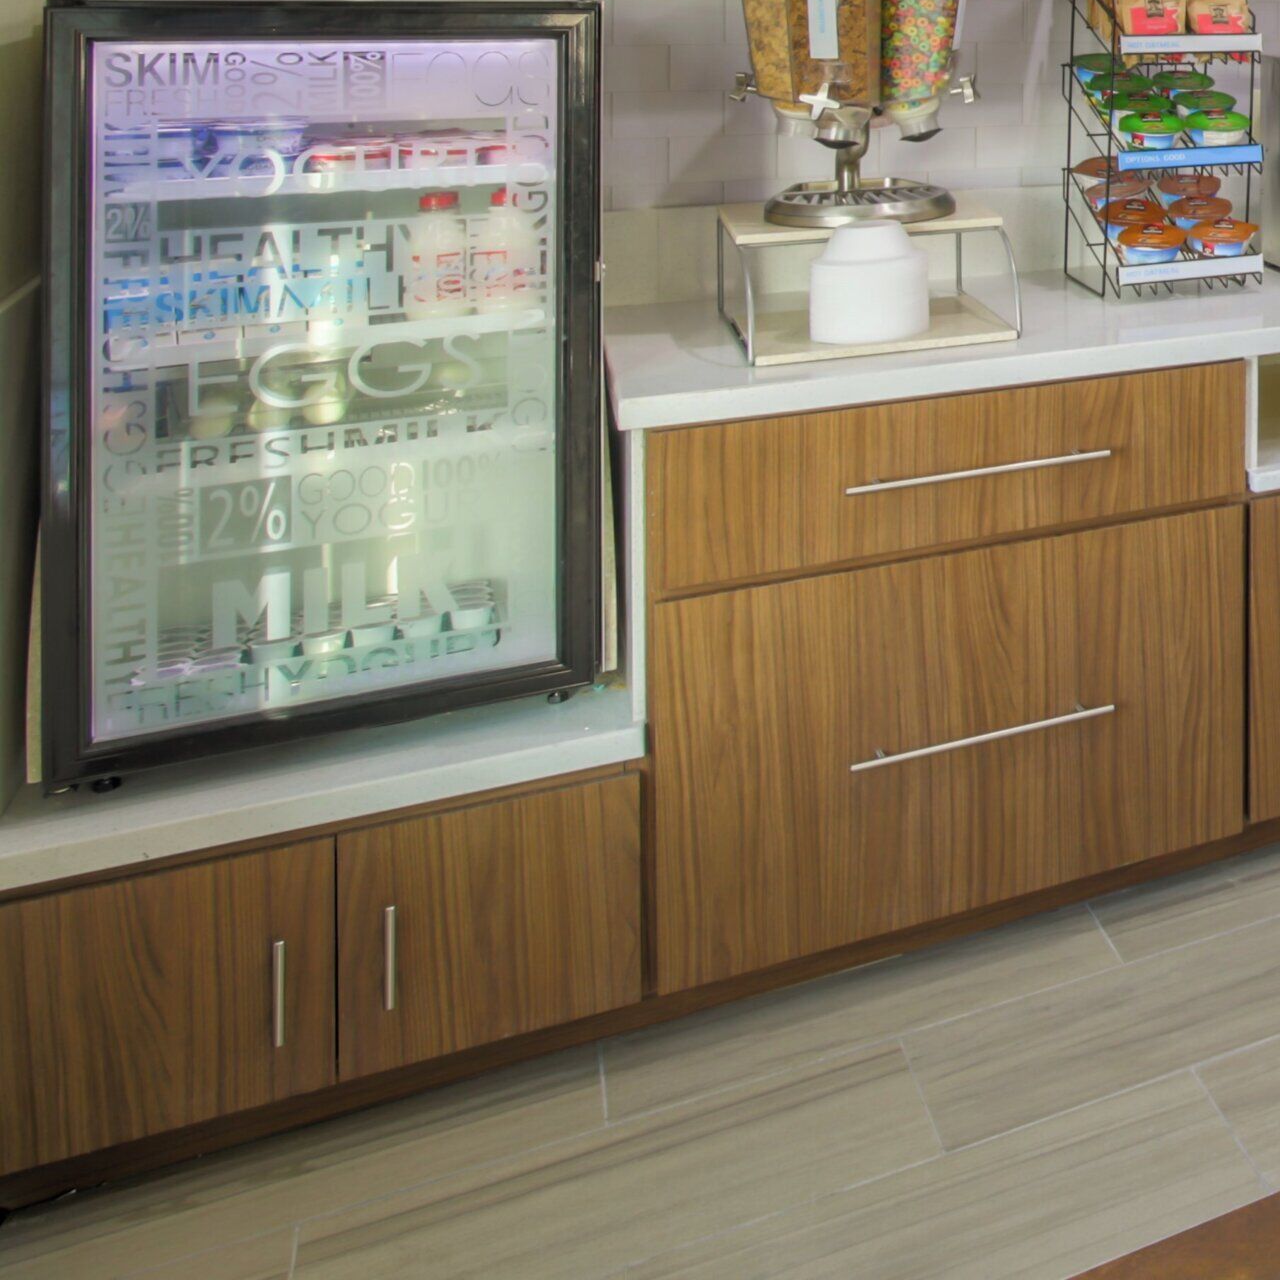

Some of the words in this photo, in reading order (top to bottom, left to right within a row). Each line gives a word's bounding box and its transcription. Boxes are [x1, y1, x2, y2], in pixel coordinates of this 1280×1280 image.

[104, 52, 220, 87] SKIM
[104, 88, 218, 117] FRESH
[106, 205, 149, 244] 2%
[155, 282, 271, 323] SKIM
[188, 332, 484, 414] EGGS
[156, 432, 335, 475] FRESH
[298, 461, 417, 505] GOOD
[208, 481, 288, 548] 2%
[104, 519, 147, 686] HEALTHY
[212, 553, 462, 650] MILK
